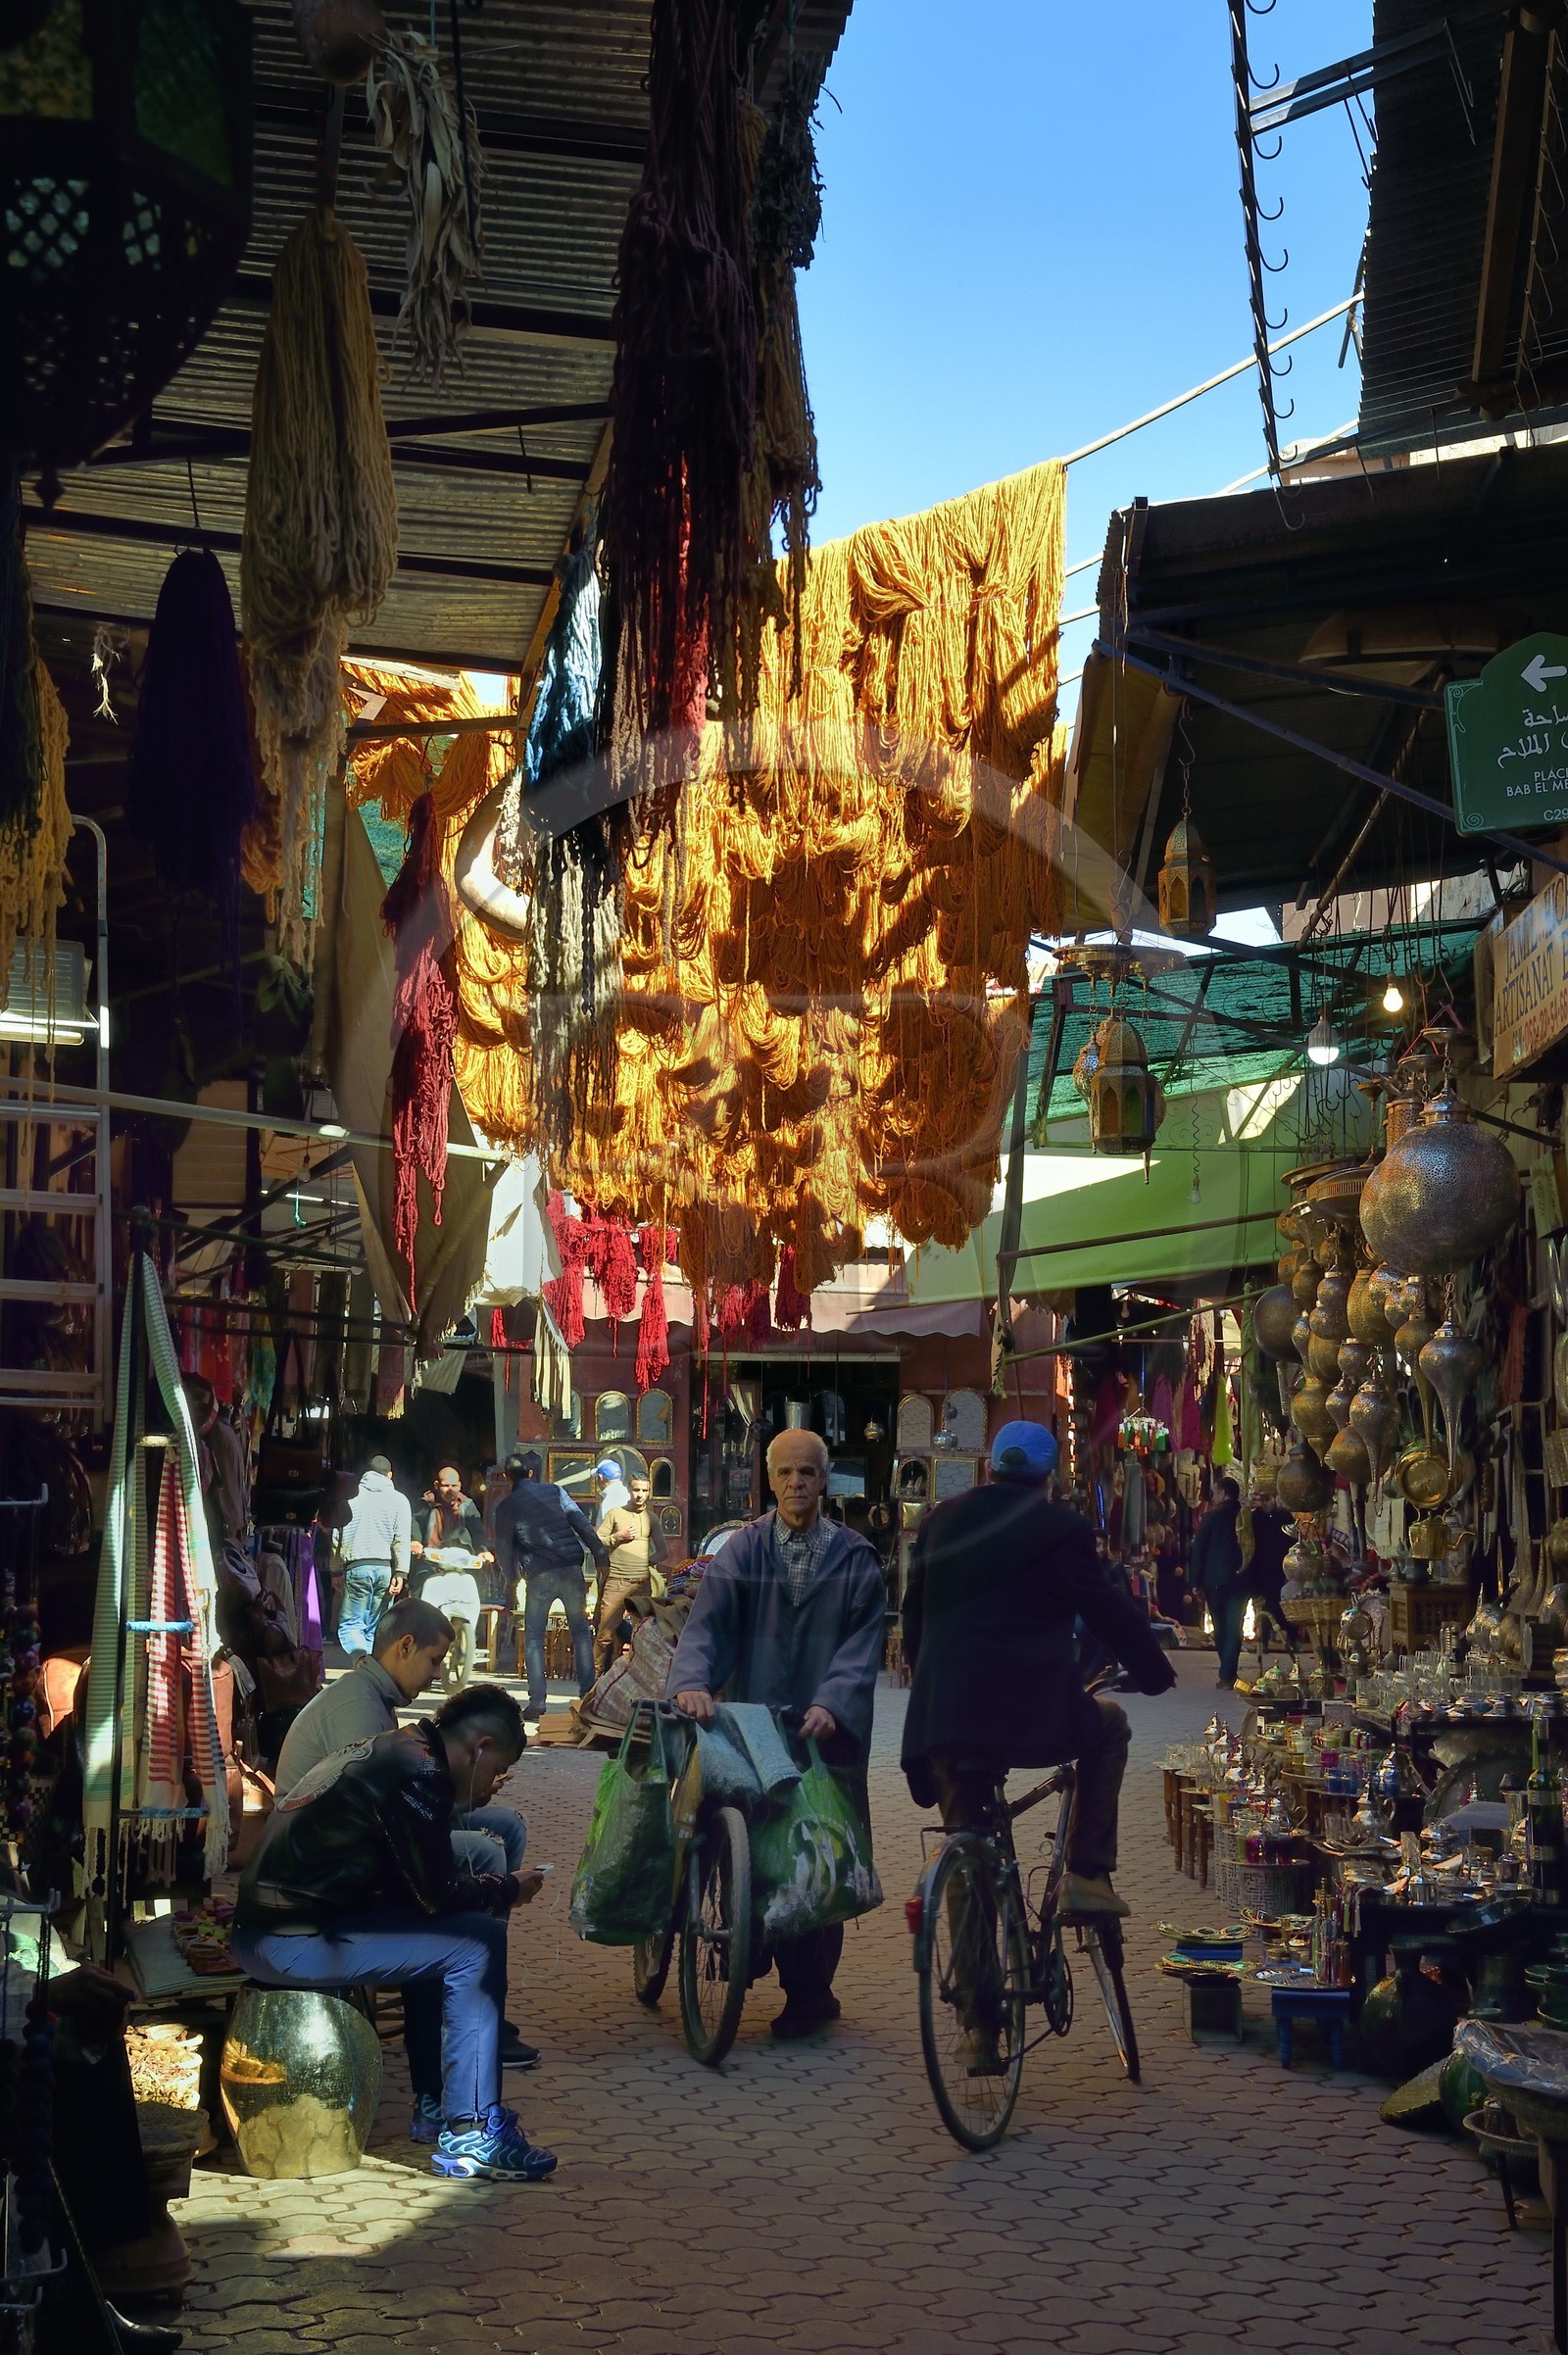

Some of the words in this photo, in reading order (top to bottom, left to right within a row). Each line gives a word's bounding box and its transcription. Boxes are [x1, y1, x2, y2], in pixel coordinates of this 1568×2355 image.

[1497, 732, 1550, 769] الملاح
[1506, 785, 1531, 797] BAB
[1535, 782, 1548, 794] EL
[1494, 943, 1554, 1038] ARTISANAT
[314, 1770, 344, 1799] PLEIN
